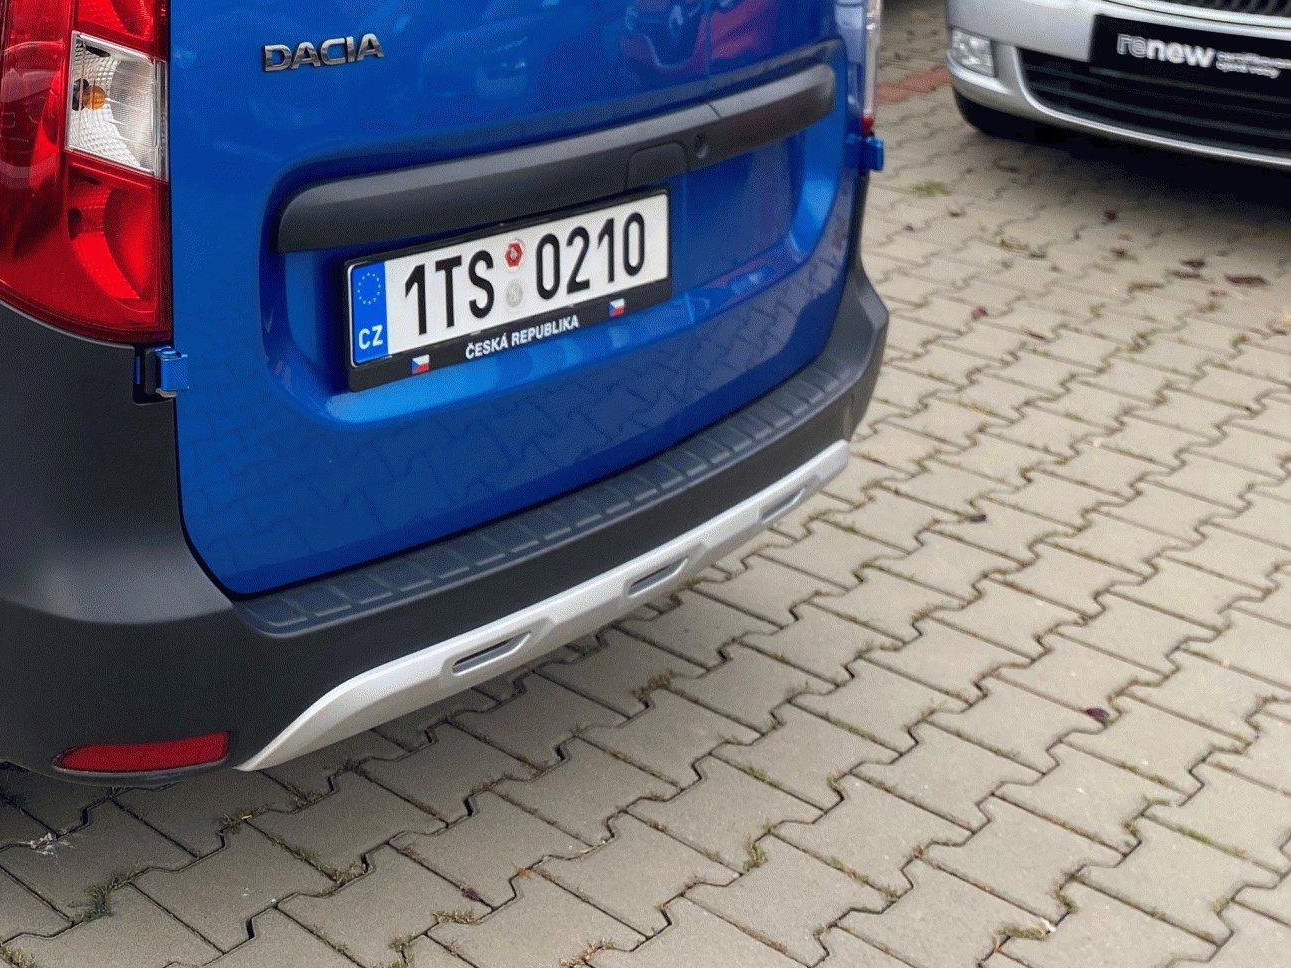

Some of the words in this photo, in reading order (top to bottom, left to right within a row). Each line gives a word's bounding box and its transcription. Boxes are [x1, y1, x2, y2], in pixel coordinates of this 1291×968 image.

[262, 32, 385, 72] DACIA
[1116, 33, 1216, 68] renew
[404, 249, 495, 336] 1TS
[535, 211, 646, 301] 0210
[358, 324, 384, 350] CZ
[465, 333, 509, 360] ČESKÁ
[511, 314, 580, 347] REPUBLIKA
